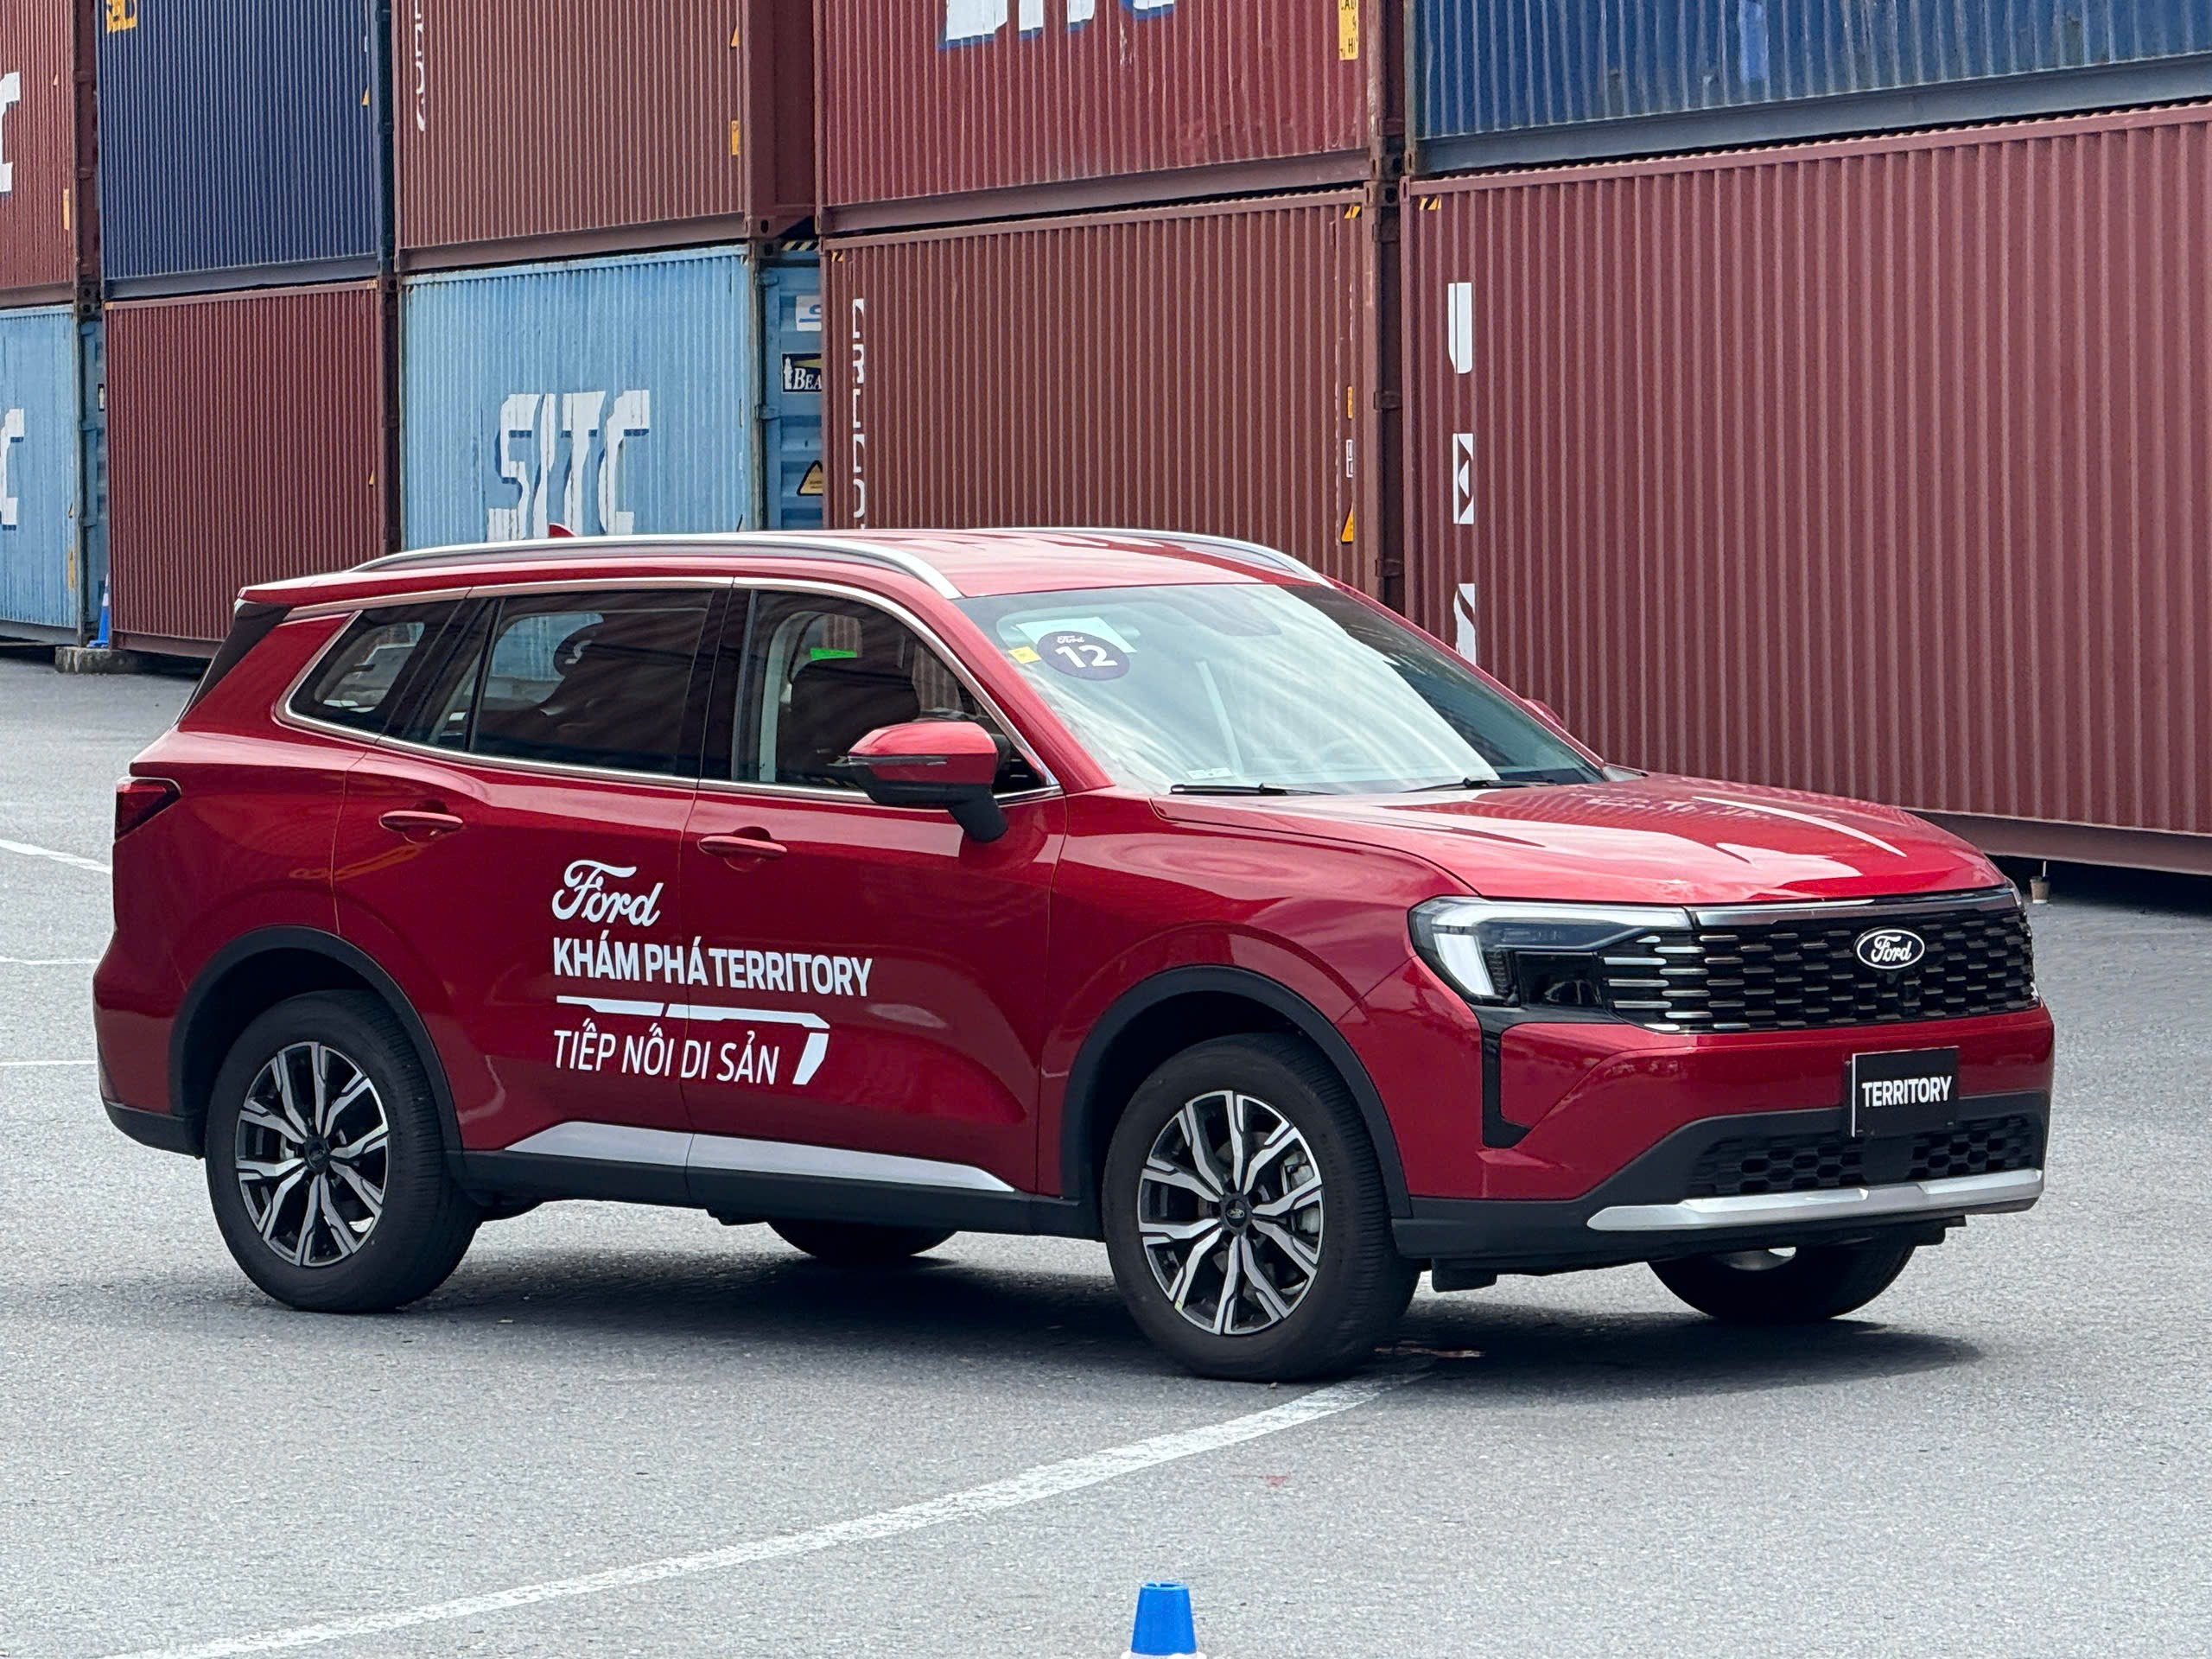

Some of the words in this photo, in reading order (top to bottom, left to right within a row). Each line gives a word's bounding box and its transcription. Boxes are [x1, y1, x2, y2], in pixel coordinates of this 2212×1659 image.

[487, 390, 650, 542] SITC
[1055, 645, 1118, 668] 12
[1057, 635, 1085, 644] Ford
[552, 860, 664, 927] Ford
[553, 930, 639, 981] KHÁM
[645, 937, 708, 986] PHÁ
[709, 949, 873, 997] TERRITORY
[1870, 935, 1912, 963] Ford
[554, 1018, 616, 1071] TIẾP
[621, 1022, 674, 1077] NỐI
[680, 1039, 711, 1080] DI
[716, 1030, 779, 1085] SẢN
[1861, 1075, 1952, 1108] TERRITORY
